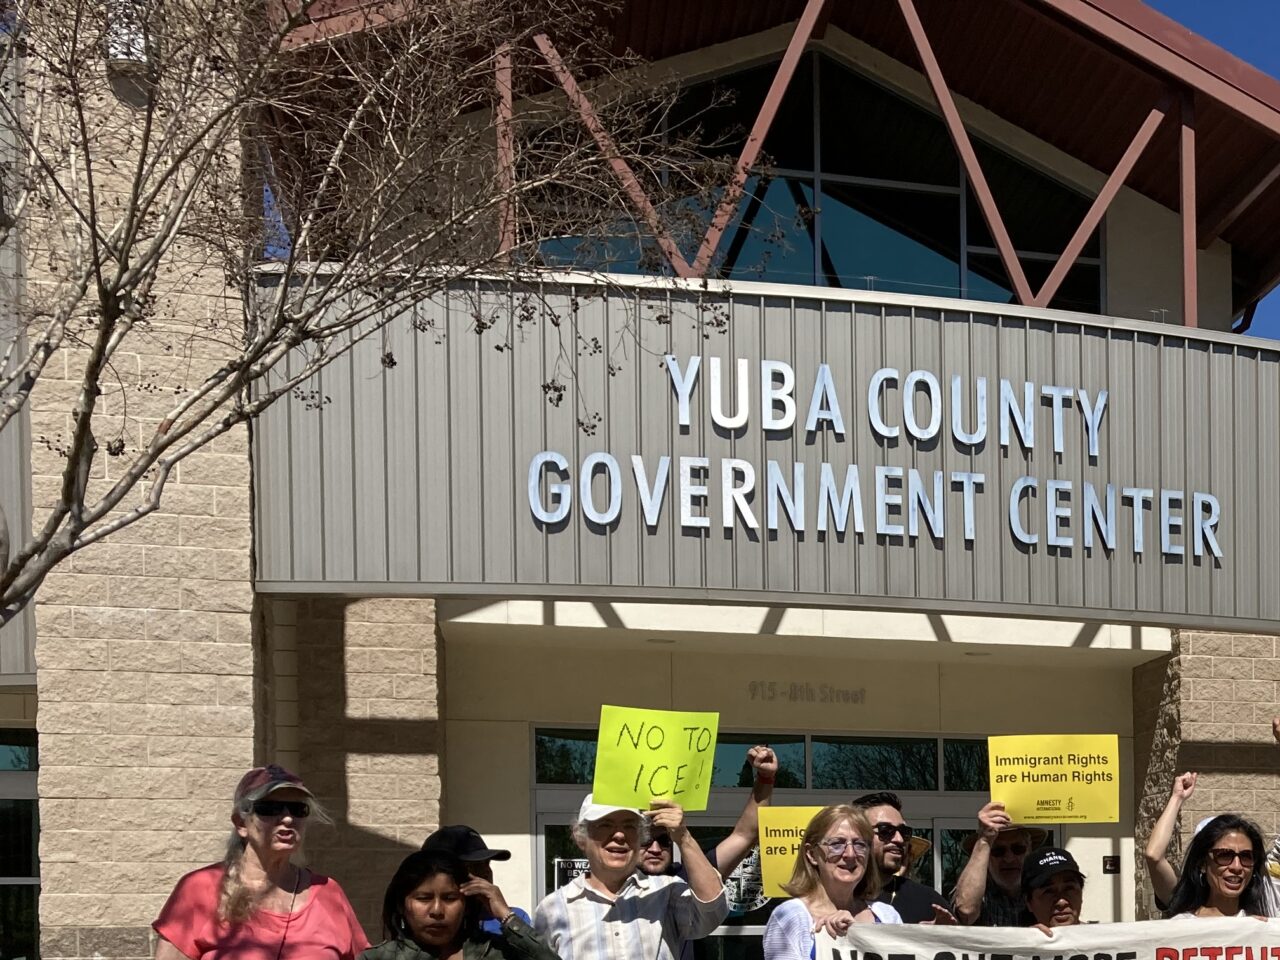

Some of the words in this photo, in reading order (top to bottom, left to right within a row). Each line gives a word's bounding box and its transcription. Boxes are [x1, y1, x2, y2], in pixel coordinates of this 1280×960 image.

[665, 354, 846, 436] YUBA
[867, 367, 1109, 458] COUNTY
[527, 451, 986, 541] GOVERNMENT
[1009, 475, 1224, 559] CENTER
[616, 721, 665, 751] NO
[683, 726, 712, 753] TO
[995, 754, 1063, 769] Immigrant
[1067, 754, 1109, 768] Rights
[995, 773, 1017, 783] are
[1021, 771, 1068, 783] Human
[1072, 771, 1113, 785] Rights
[1036, 799, 1062, 807] AMNESTY
[765, 826, 807, 841] Immig
[765, 845, 787, 855] are
